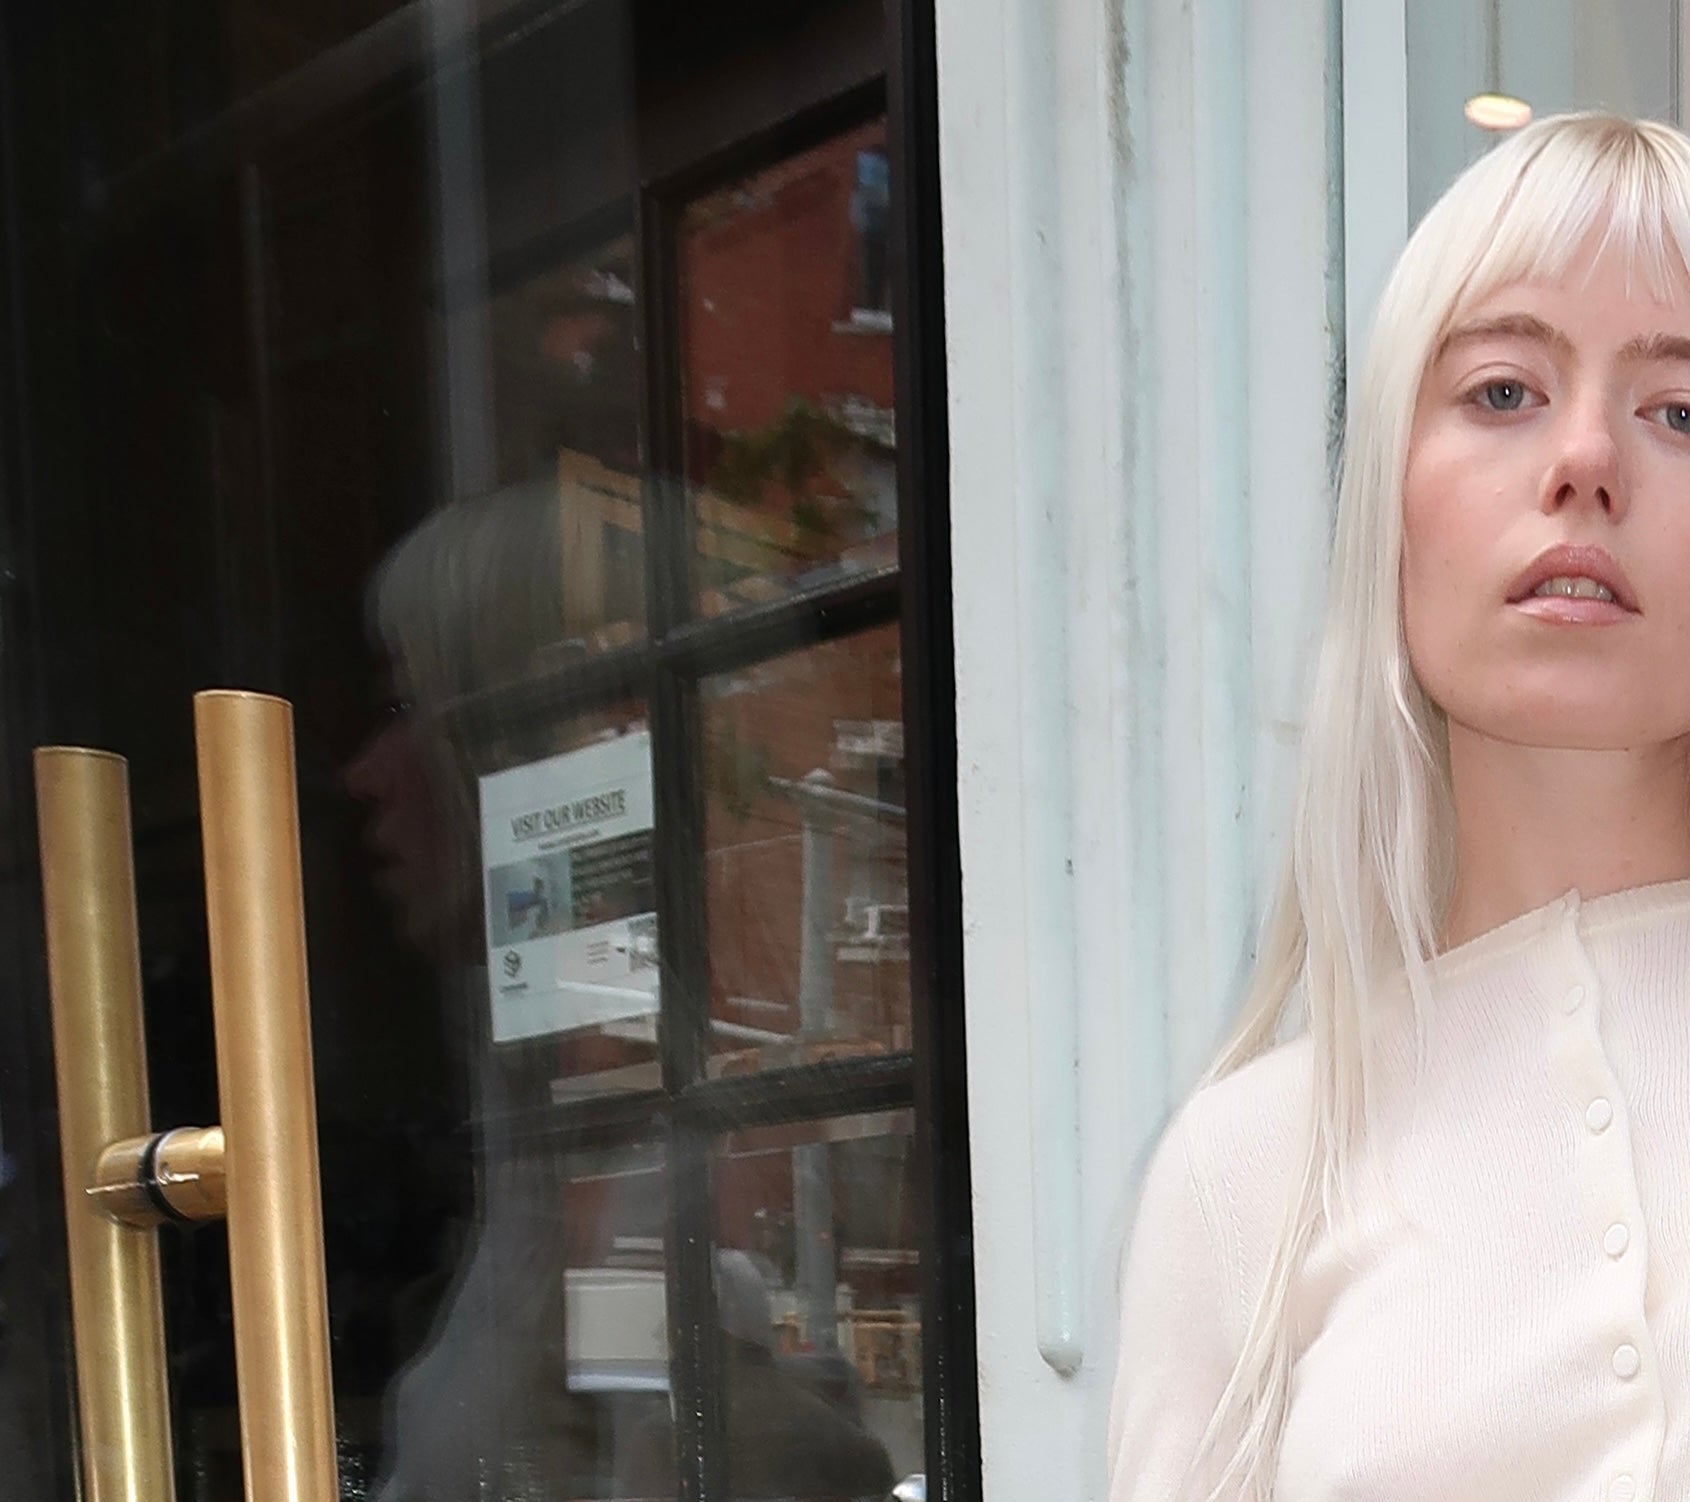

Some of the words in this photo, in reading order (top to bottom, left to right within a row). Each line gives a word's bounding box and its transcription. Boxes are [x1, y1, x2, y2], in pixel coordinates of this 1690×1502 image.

[510, 810, 541, 839] VISIT
[543, 803, 571, 829] OUR
[572, 788, 626, 820] WEBSITE
